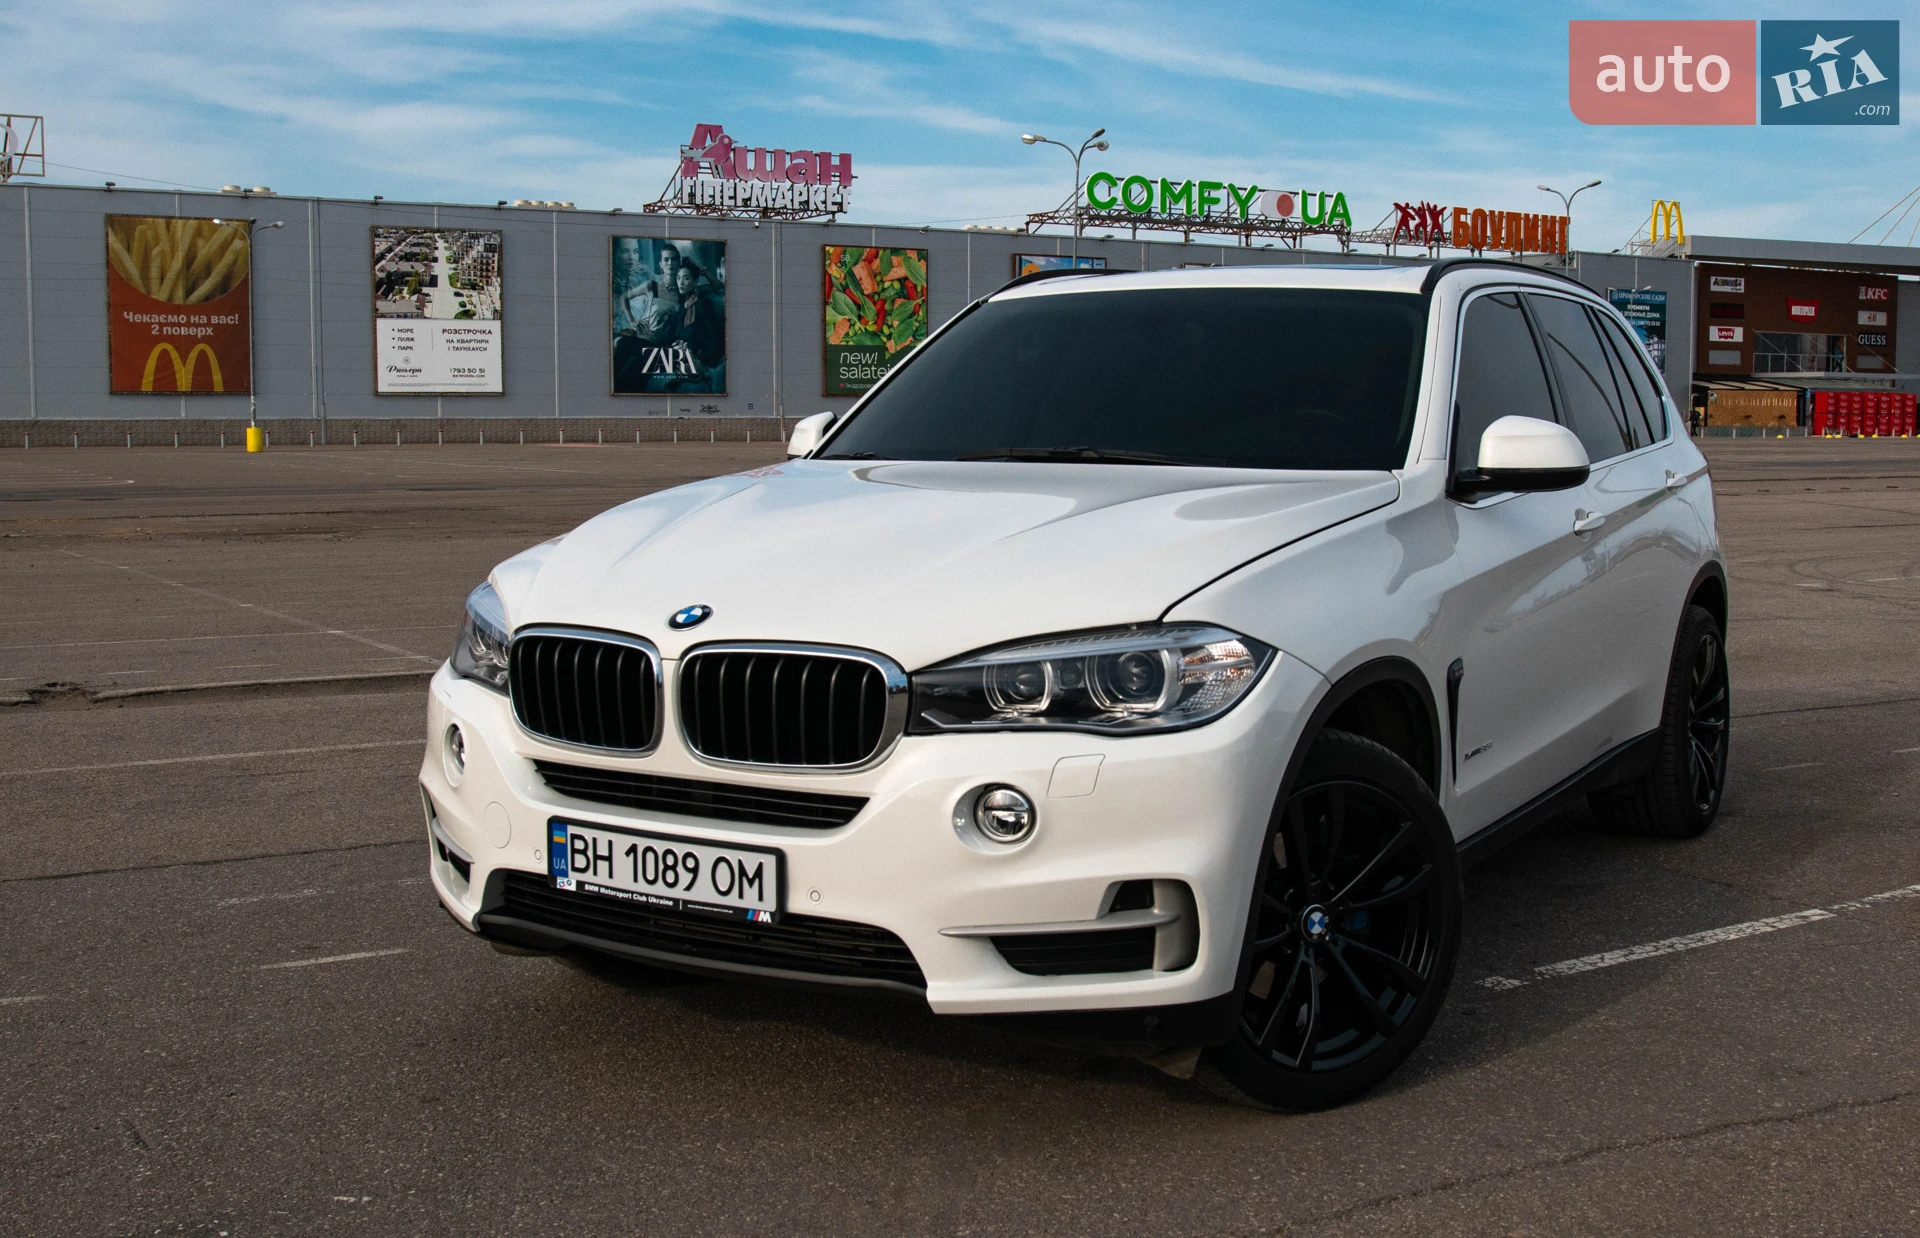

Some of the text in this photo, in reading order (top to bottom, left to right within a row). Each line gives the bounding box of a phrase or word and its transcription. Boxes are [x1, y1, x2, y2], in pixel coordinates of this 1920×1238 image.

[681, 123, 852, 186] Ашан
[682, 179, 852, 212] ГІПЕРМАРКЕТ
[1085, 171, 1353, 228] COMFY UA
[1452, 206, 1571, 255] БОУЛИНГ
[1867, 288, 1888, 300] KFC
[123, 311, 239, 324] Чекаємо на вас!
[151, 324, 214, 338] 2 поверх
[442, 328, 493, 336] РОЗСТРОЧКА
[1858, 334, 1887, 346] GUESS
[641, 347, 698, 375] ZARA
[840, 352, 878, 364] new!
[553, 857, 567, 871] UA
[569, 832, 764, 902] BH 1089 OM
[584, 883, 600, 893] BMW
[600, 886, 632, 899] Motorsport
[632, 893, 647, 902] Club
[648, 895, 674, 906] Ukraine
